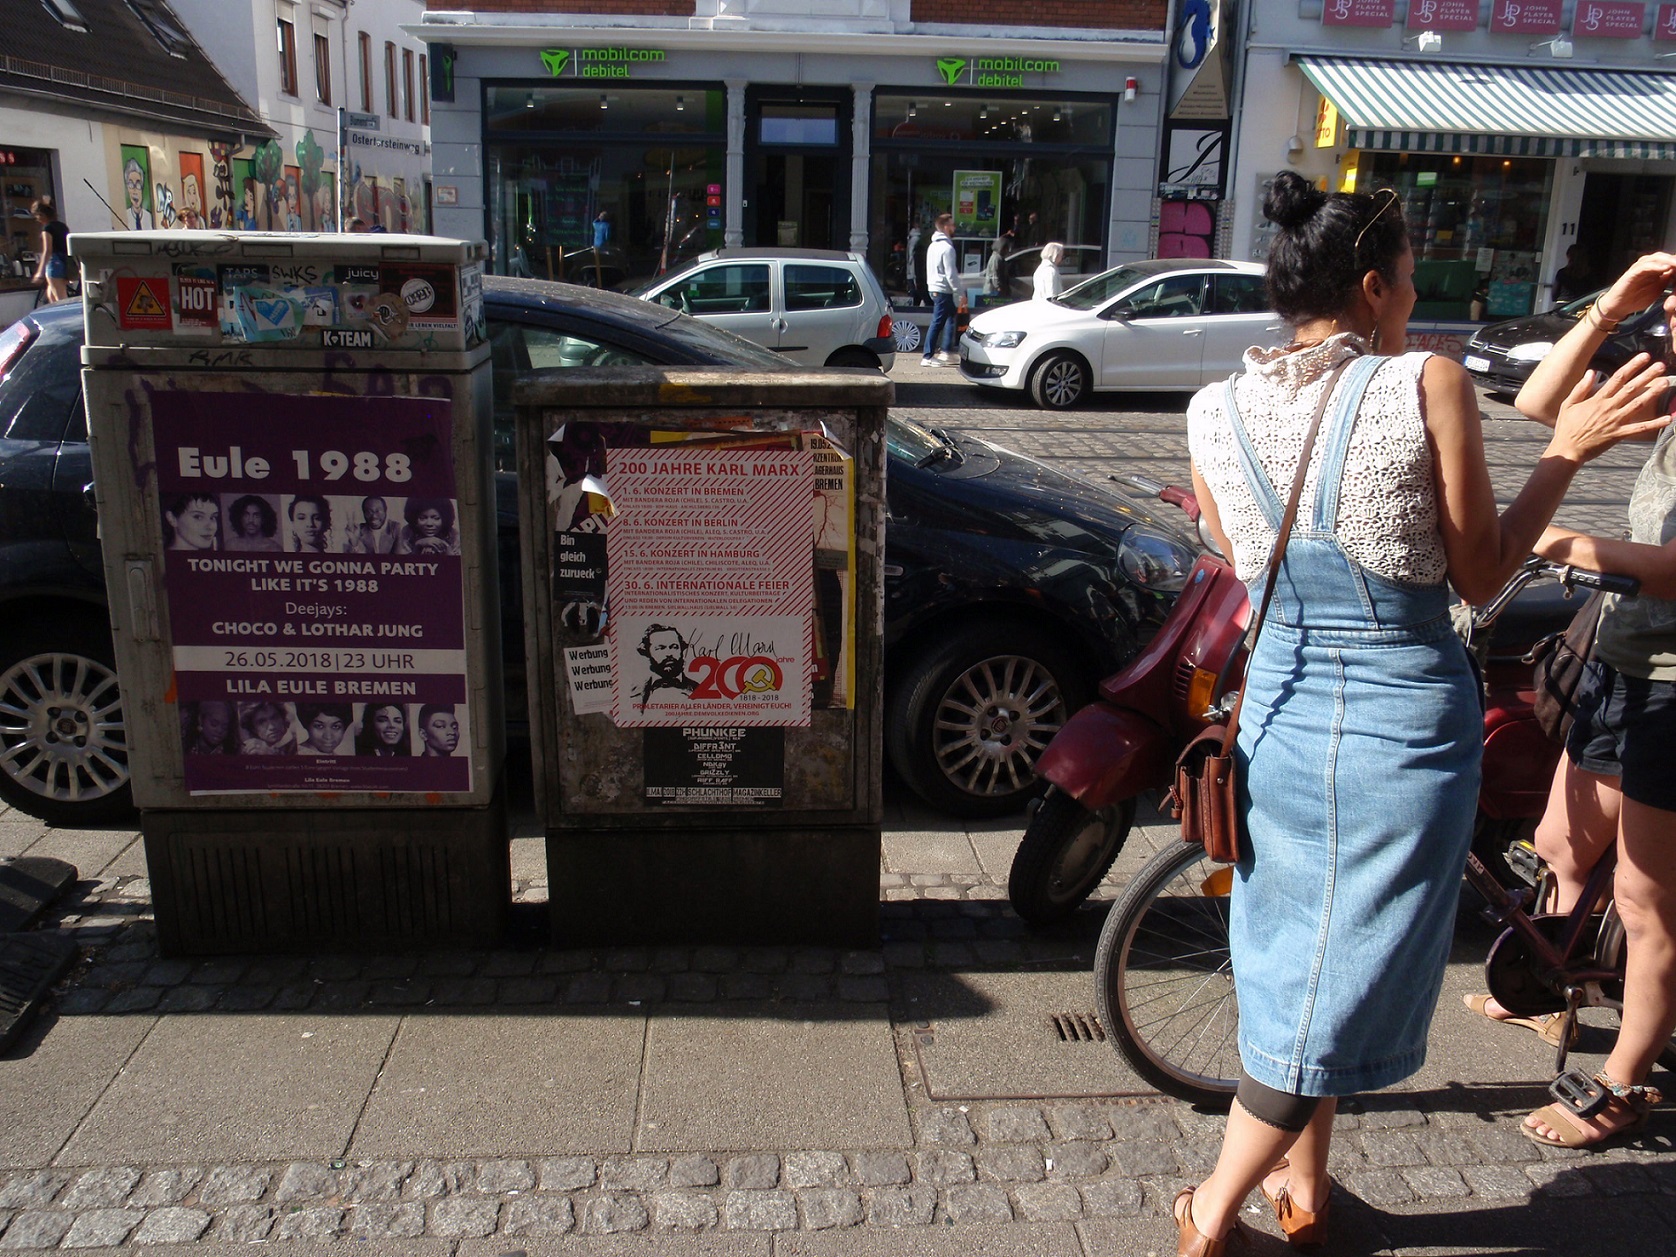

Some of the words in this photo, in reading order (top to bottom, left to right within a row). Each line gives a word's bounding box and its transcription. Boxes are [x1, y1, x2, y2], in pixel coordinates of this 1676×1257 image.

[1354, 10, 1389, 18] SPECIAL
[1605, 21, 1640, 29] SPECIAL
[582, 47, 665, 61] mobilcom
[979, 57, 1060, 72] mobilcom
[582, 64, 630, 78] debitel
[978, 73, 1024, 88] debitel
[1562, 223, 1576, 235] 11
[346, 267, 380, 281] juicy
[181, 286, 215, 311] HOT
[177, 445, 271, 480] Eule
[291, 449, 413, 483] 1988
[618, 461, 647, 474] 200
[650, 462, 702, 475] JAHRE
[706, 463, 748, 475] KARL
[752, 463, 800, 476] MARX
[815, 478, 843, 490] BREMEN
[622, 487, 631, 496] 1.
[633, 487, 642, 496] 6.
[643, 487, 689, 496] KONZERT
[691, 487, 702, 496] IN
[704, 487, 744, 496] BREMEN
[622, 518, 632, 527] 8.
[633, 518, 643, 527] 6.
[644, 518, 690, 527] KONZERT
[691, 518, 703, 527] IN
[704, 518, 738, 527] BERLIN
[560, 534, 575, 546] Bin
[560, 551, 586, 563] gleich
[623, 549, 637, 558] 15.
[639, 549, 649, 558] 6.
[650, 550, 695, 558] KONZERT
[697, 550, 707, 558] IN
[710, 550, 760, 558] HAMBURG
[187, 558, 269, 574] TONIGHT
[273, 560, 304, 573] WE
[308, 560, 376, 575] GONNA
[381, 562, 439, 576] PARTY
[560, 569, 595, 580] zurueck
[251, 578, 291, 591] LIKE
[296, 578, 328, 592] IT'S
[334, 579, 379, 593] 1988
[624, 580, 641, 590] 30.
[644, 580, 654, 590] 6.
[656, 581, 755, 590] INTERNATIONALE
[758, 581, 790, 590] FEIER
[285, 601, 347, 619] Deejays:
[212, 621, 278, 636] CHOCO
[282, 622, 297, 636] &
[301, 623, 373, 637] LOTHAR
[376, 623, 424, 638] JUNG
[372, 653, 415, 669] UHR
[568, 649, 608, 661] Werbung
[571, 664, 612, 676] Werbung
[688, 656, 783, 700] 200
[226, 679, 272, 693] LILA
[277, 680, 328, 694] EULE
[334, 681, 416, 696] BREMEN
[733, 703, 770, 711] VEREINIGT
[682, 728, 747, 738] PHUNKEE
[687, 787, 732, 797] SCHLACHTHOF
[733, 788, 782, 798] MAGAZINKELLER
